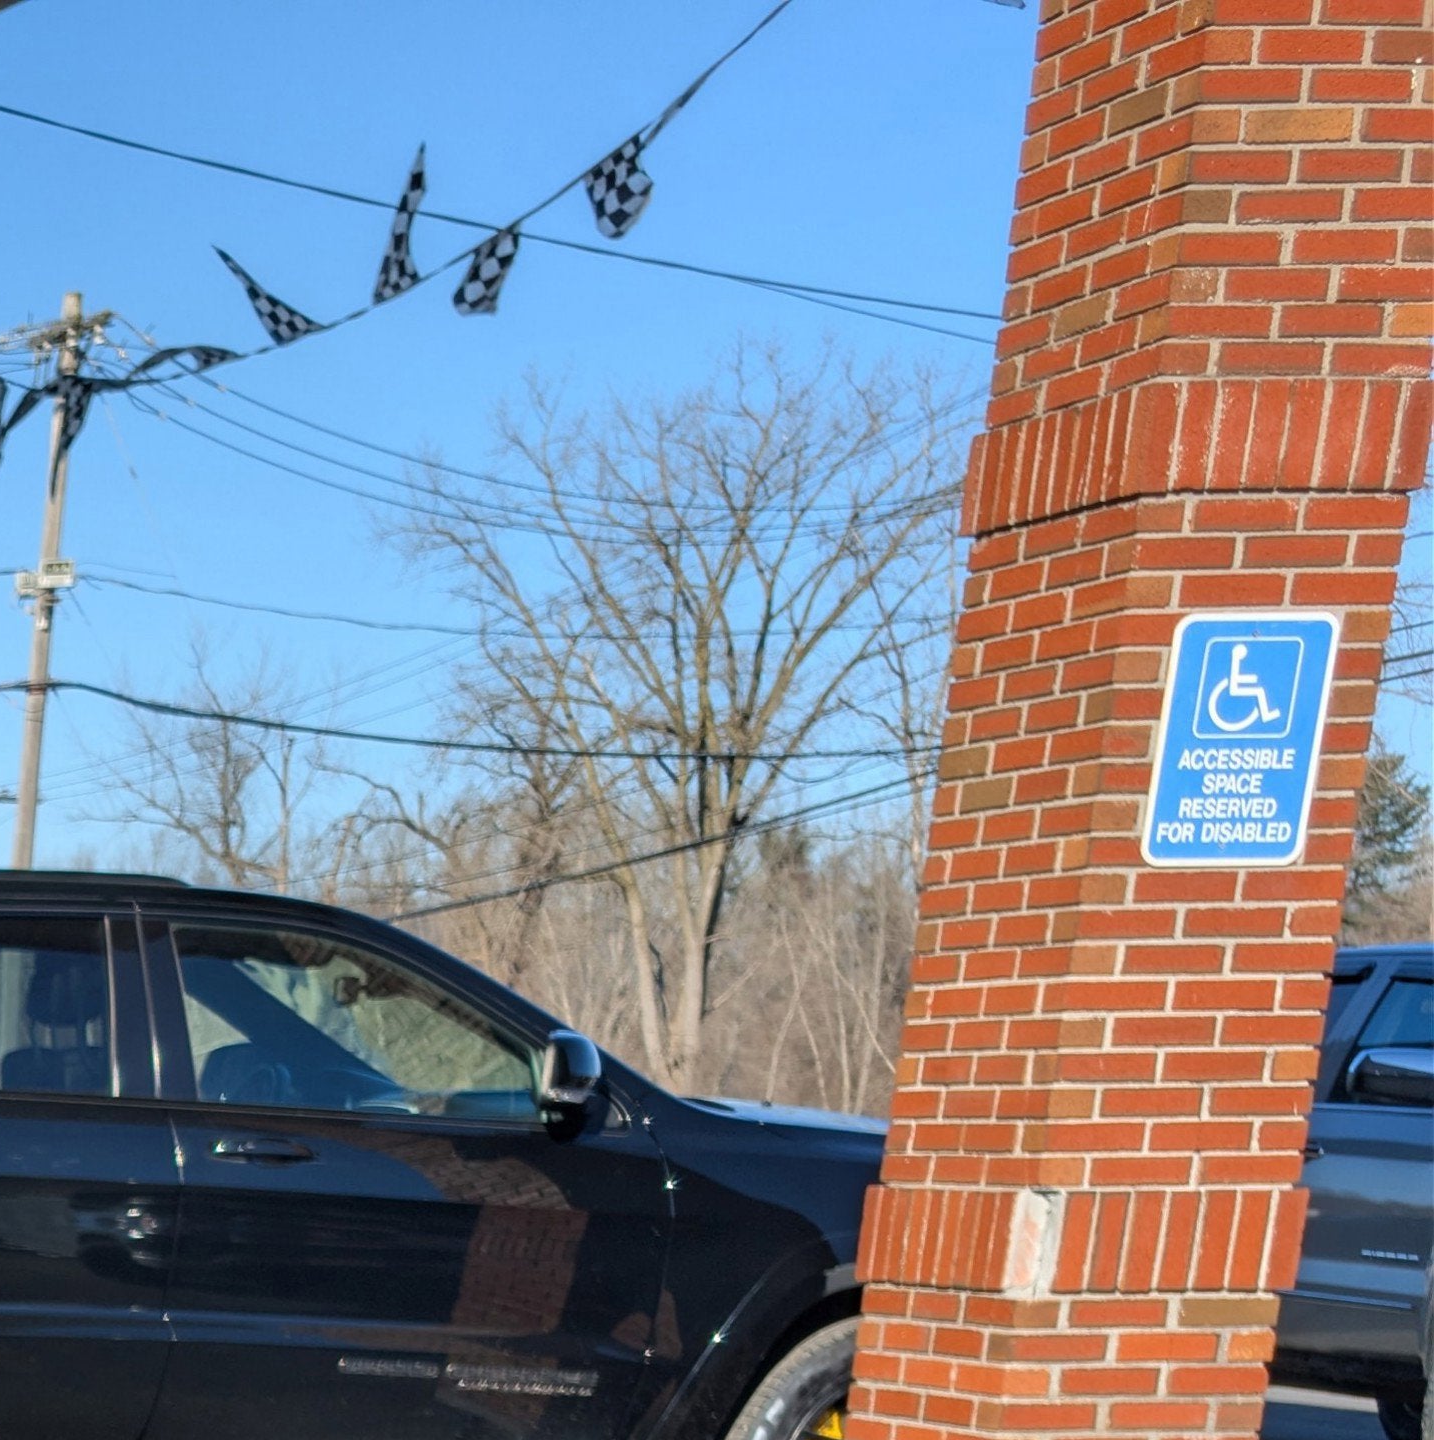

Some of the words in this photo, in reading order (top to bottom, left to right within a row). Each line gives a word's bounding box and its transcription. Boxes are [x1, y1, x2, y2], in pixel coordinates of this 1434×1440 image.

[1177, 748, 1296, 770] ACCESSIBLE
[1201, 773, 1264, 795] SPACE
[1177, 797, 1278, 819] RESERVED
[1155, 822, 1195, 844] FOR
[1200, 821, 1291, 844] DISABLED
